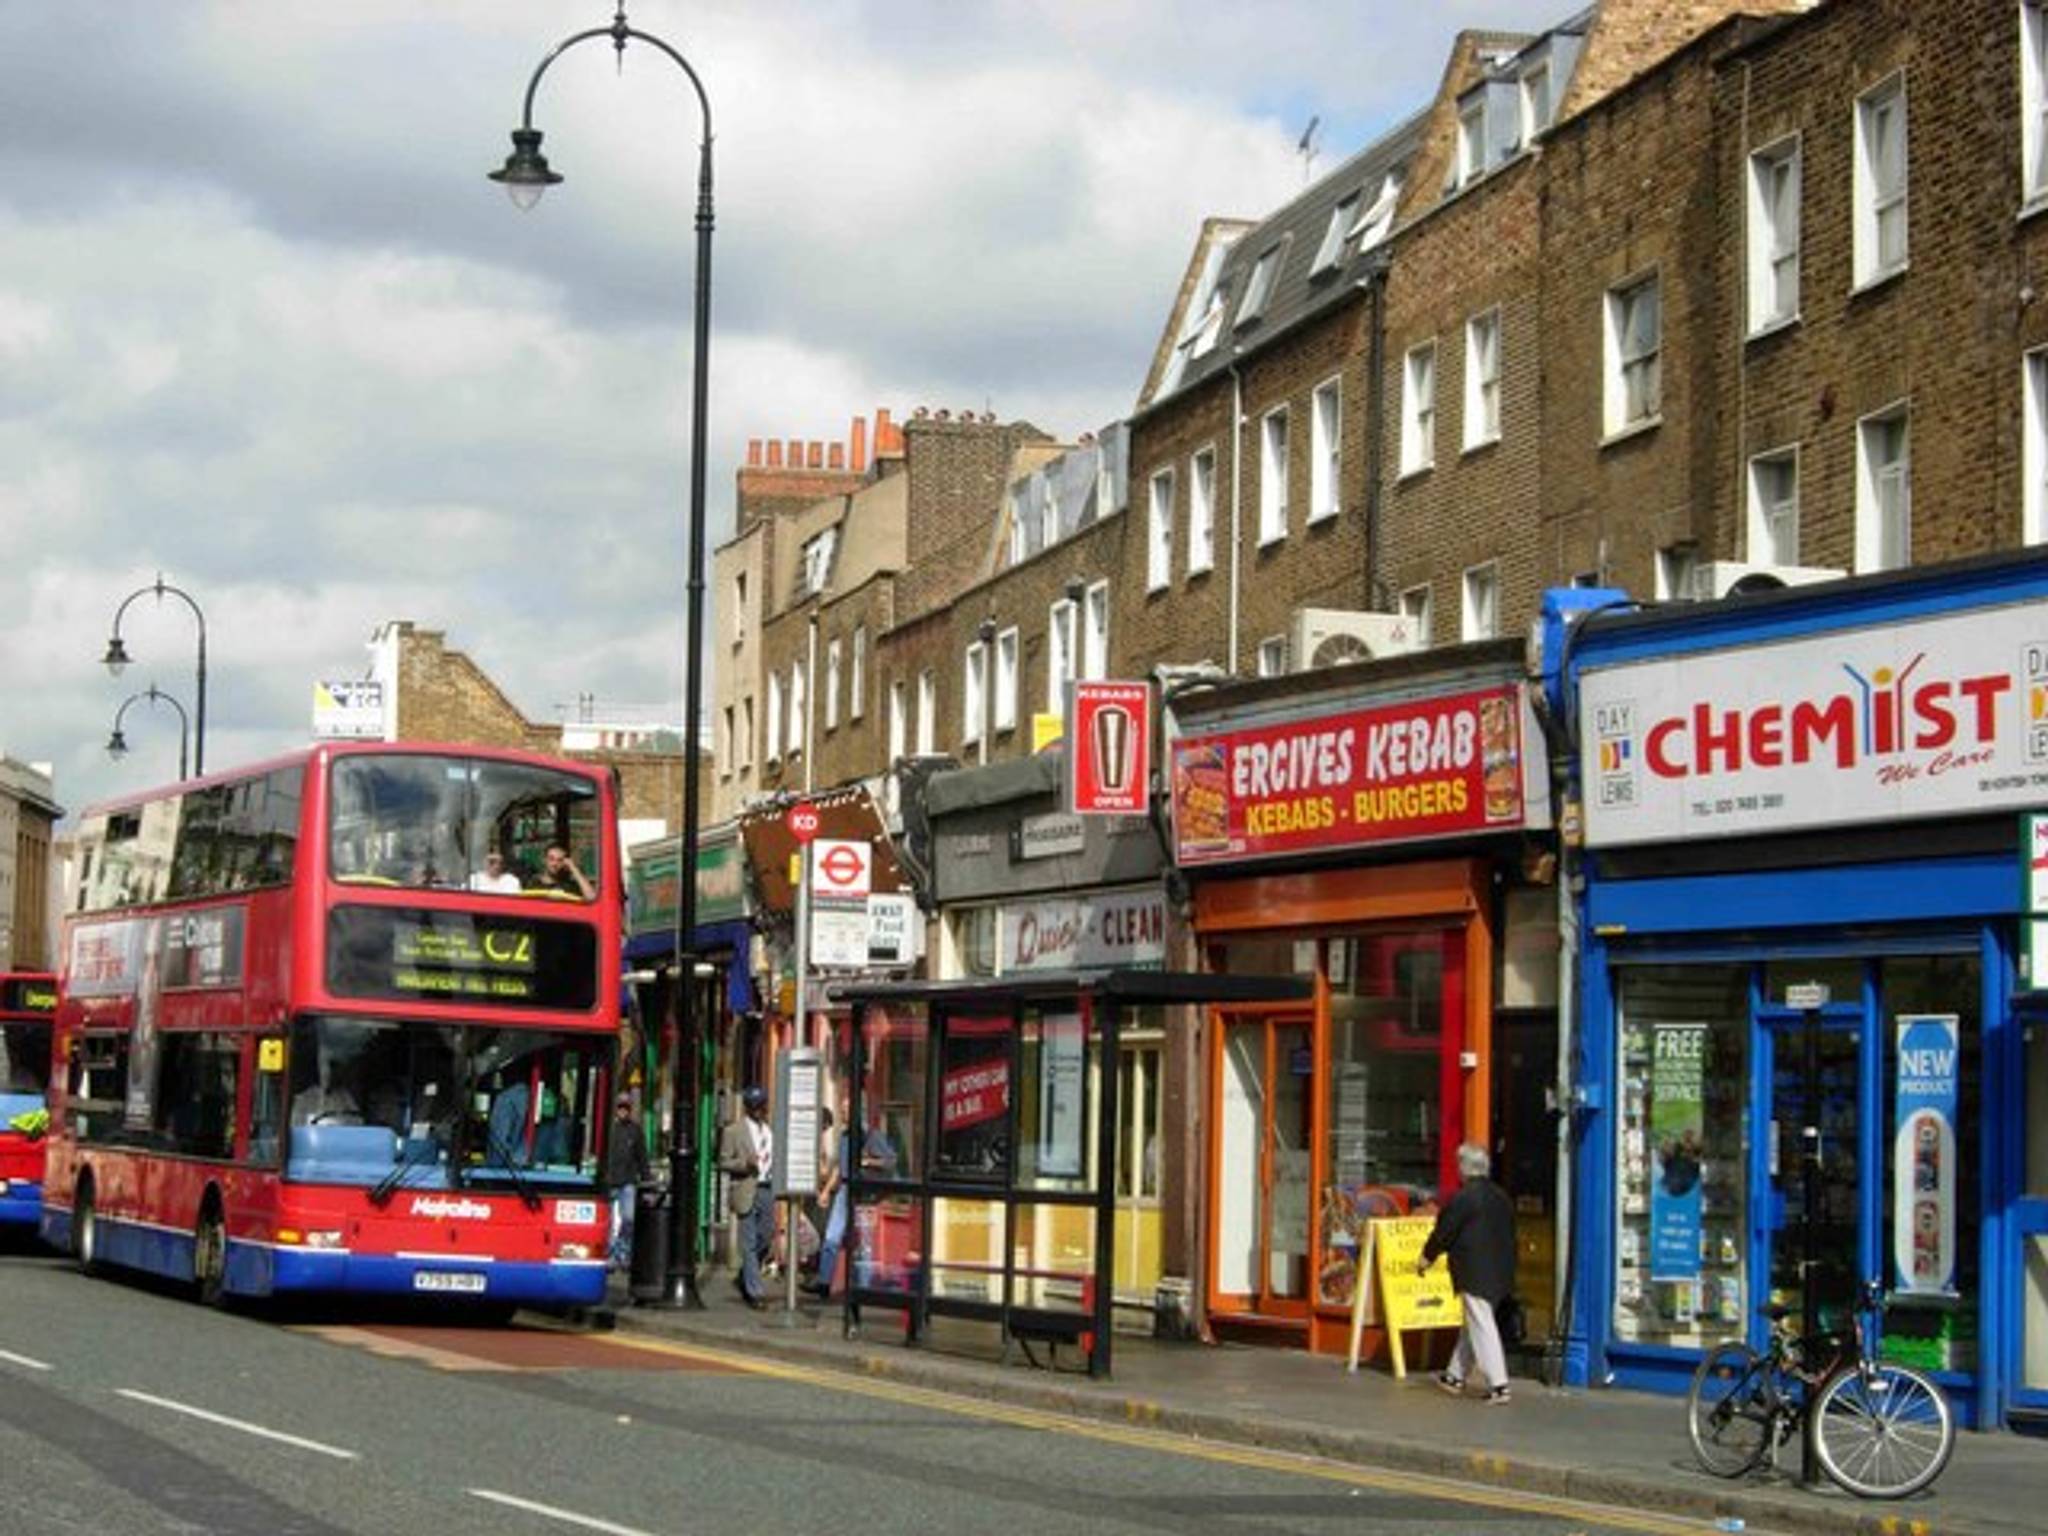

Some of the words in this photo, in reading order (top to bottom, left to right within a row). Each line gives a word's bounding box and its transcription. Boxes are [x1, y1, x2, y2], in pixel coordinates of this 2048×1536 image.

[1078, 688, 1144, 700] KEBABS
[1597, 705, 1630, 732] DAY
[1232, 728, 1355, 798] ERCIYES
[1366, 709, 1476, 782] KEBAB
[1876, 762, 1919, 786] We
[1928, 749, 1995, 777] Care
[1093, 795, 1134, 808] OPEN
[1600, 779, 1633, 805] LEWIS
[1246, 796, 1335, 836] KEBABS
[1354, 777, 1468, 824] BURGERS
[1103, 902, 1163, 946] CLEAN
[486, 930, 530, 962] C2
[1656, 1029, 1703, 1058] FREE
[1901, 1049, 1954, 1077] NEW
[410, 1195, 492, 1221] Metroline
